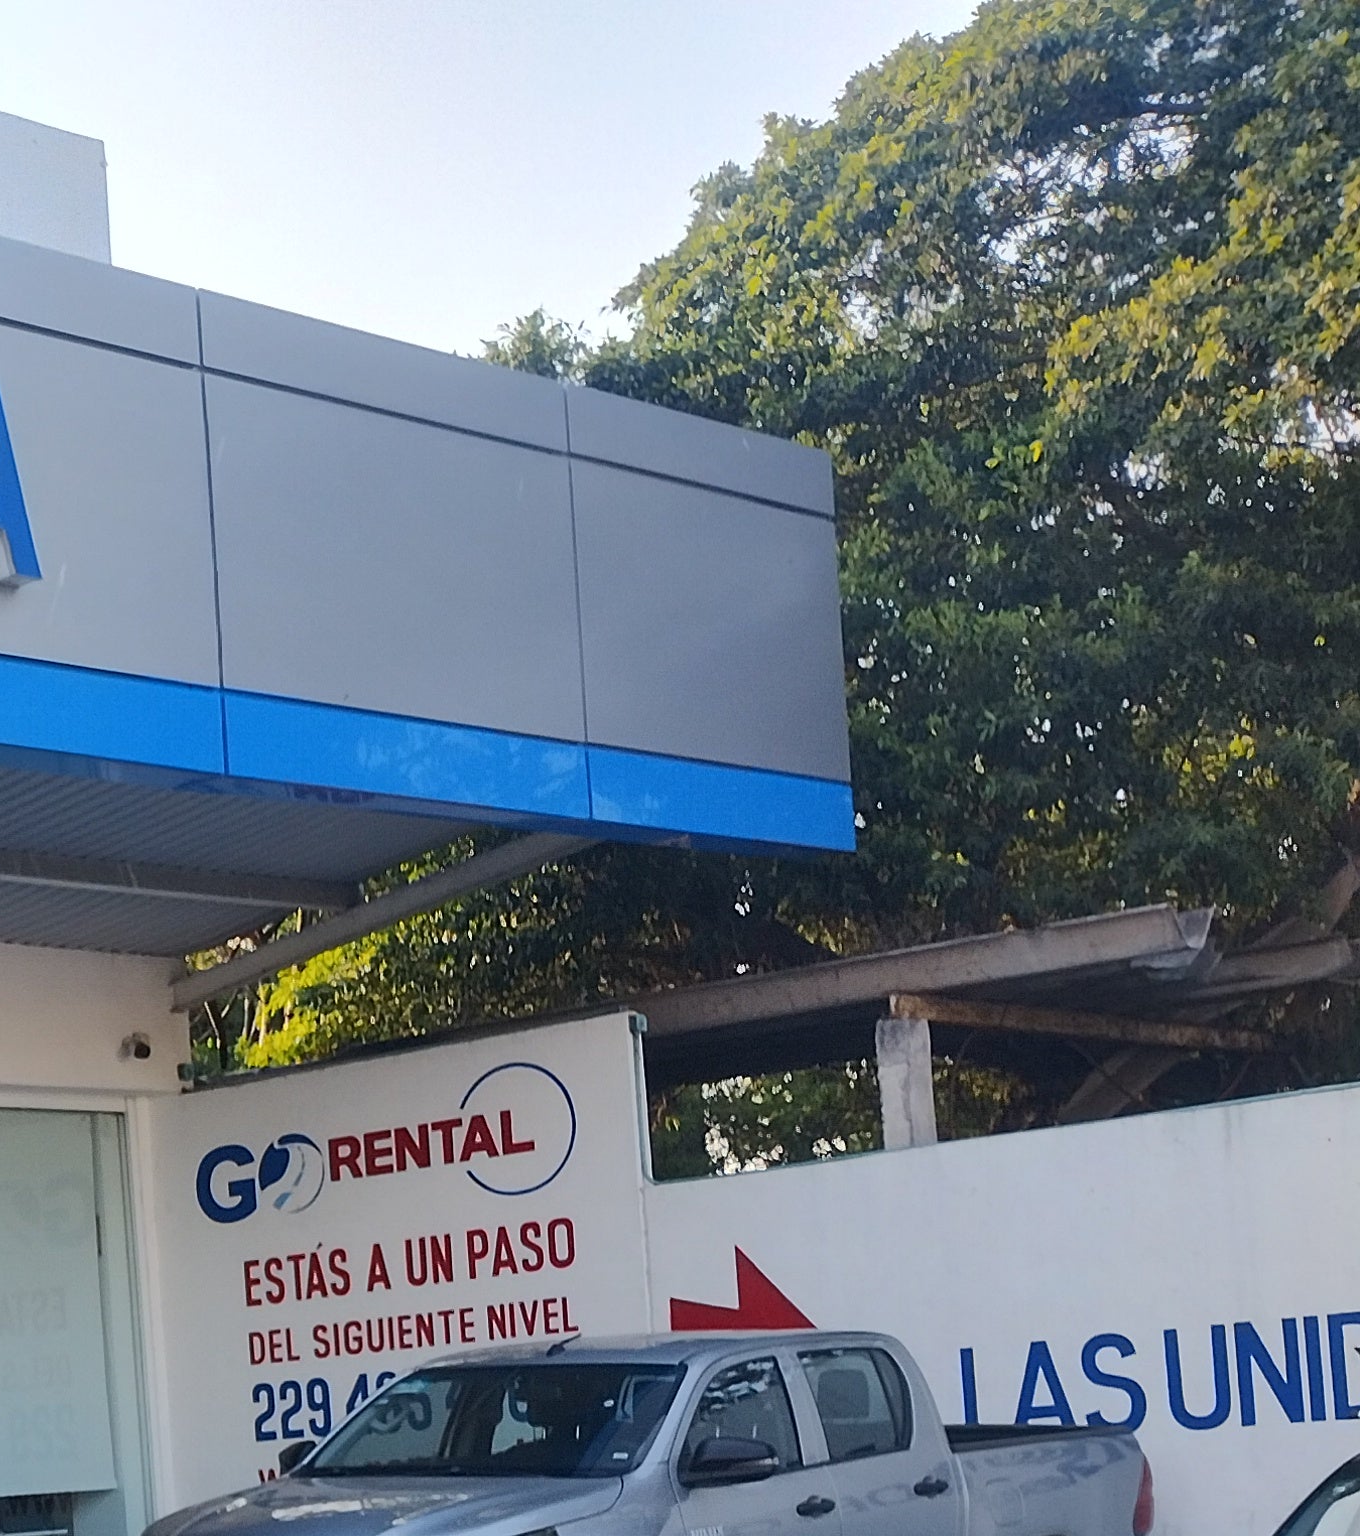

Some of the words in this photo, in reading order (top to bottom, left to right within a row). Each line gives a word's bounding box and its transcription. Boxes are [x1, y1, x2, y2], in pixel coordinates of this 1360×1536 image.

[328, 1110, 535, 1182] RENTAL
[243, 1241, 350, 1306] ESTÁS
[367, 1243, 391, 1292] A
[405, 1233, 454, 1287] UN
[467, 1217, 576, 1280] PASO
[248, 1327, 300, 1365] DEL
[312, 1307, 475, 1357] SIGUIENTE
[487, 1296, 579, 1341] NIVEL
[251, 1377, 331, 1442] 229
